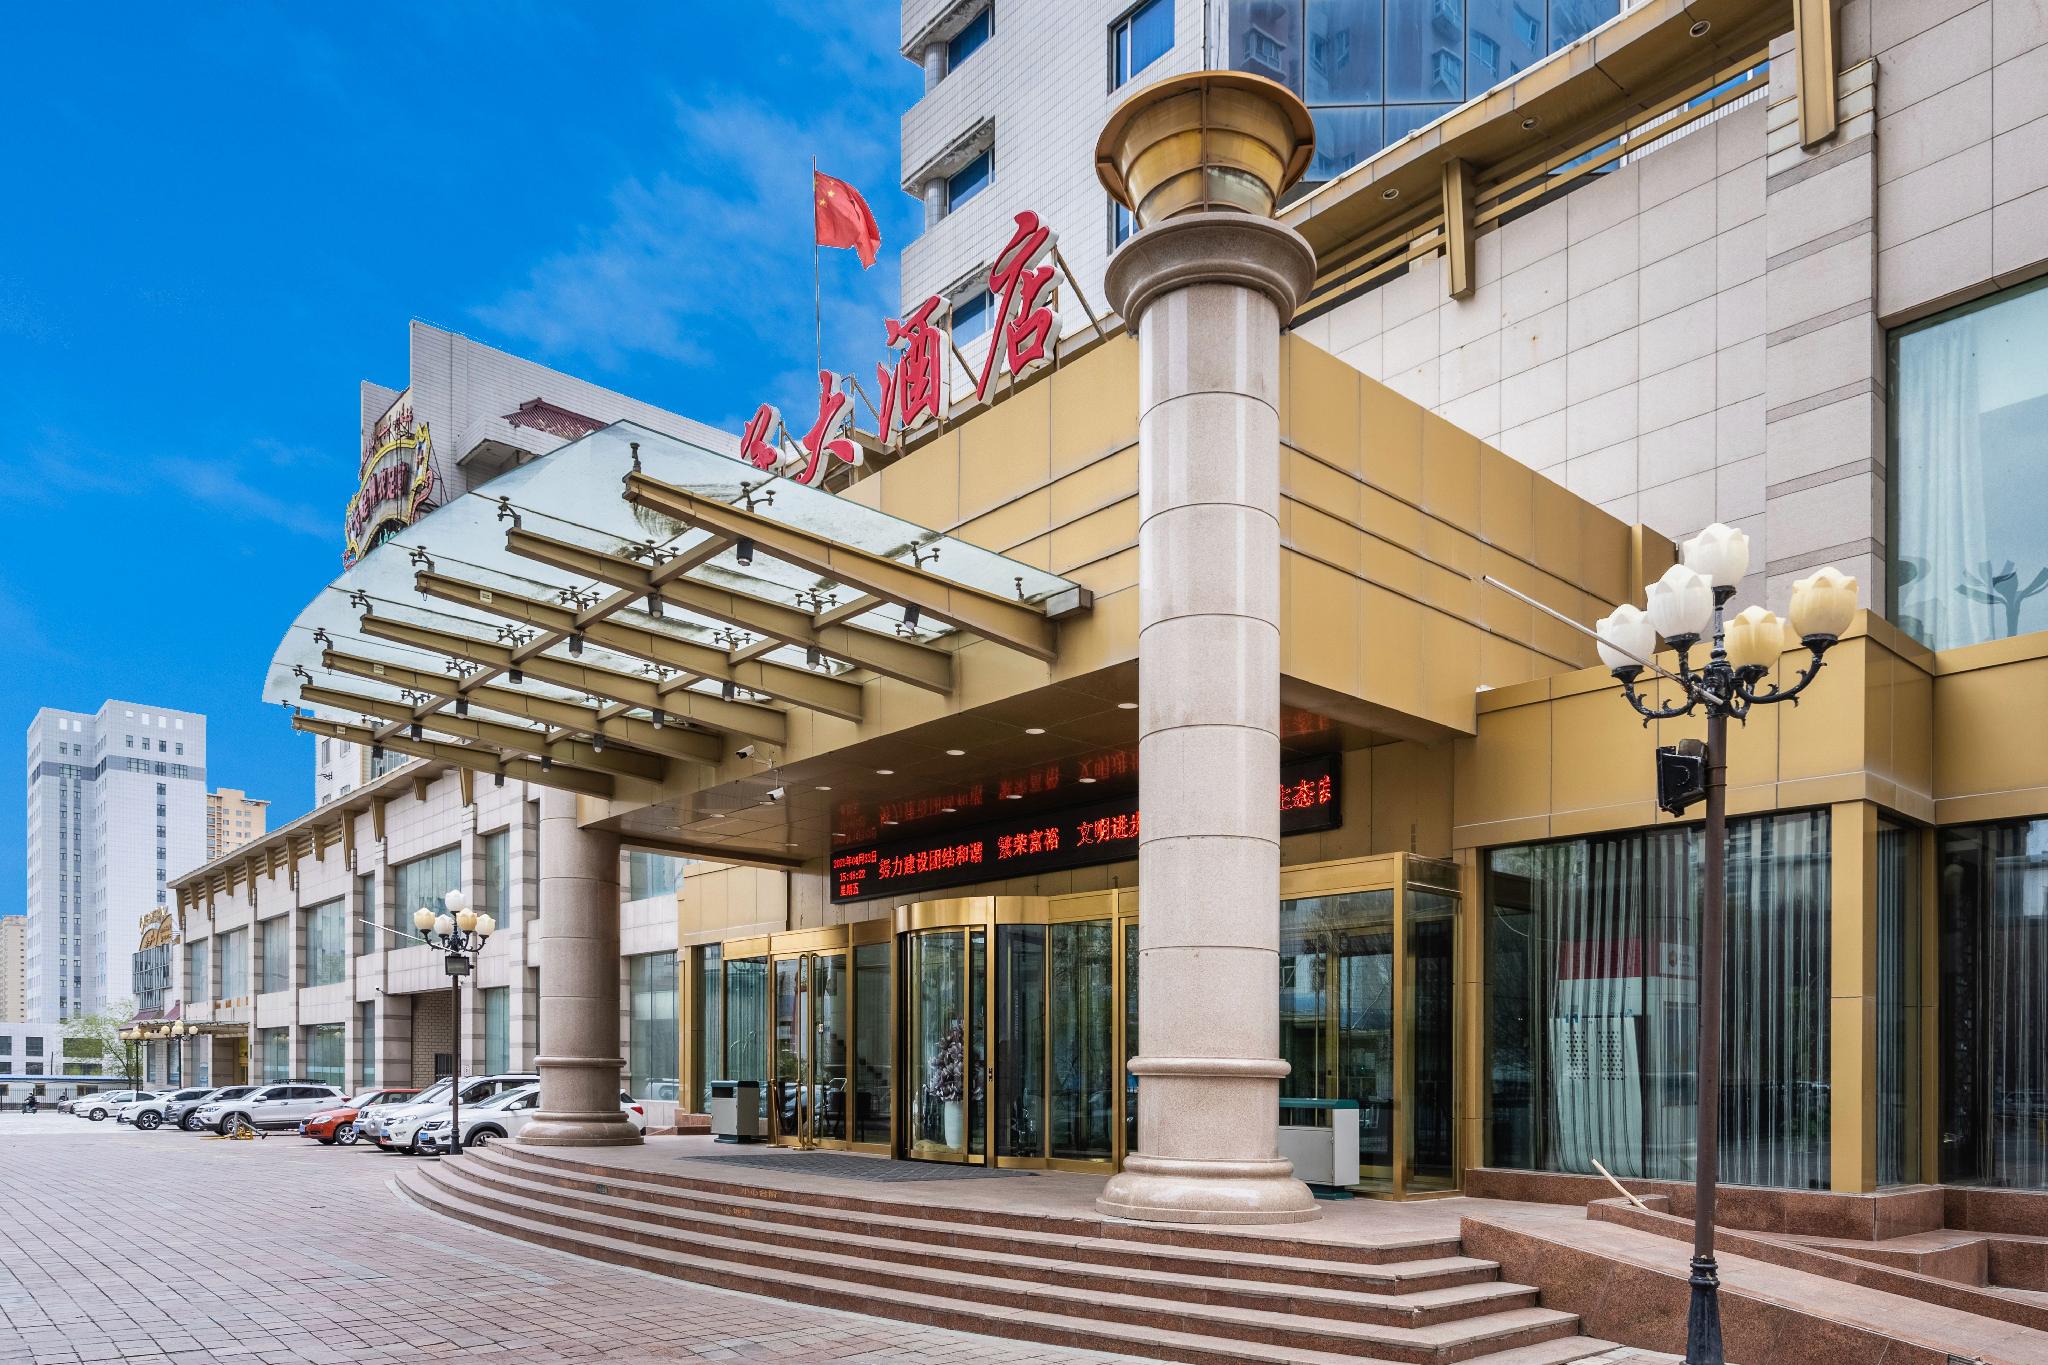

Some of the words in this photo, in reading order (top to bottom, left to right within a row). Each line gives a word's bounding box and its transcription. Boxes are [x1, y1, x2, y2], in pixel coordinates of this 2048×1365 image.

[879, 841, 983, 880] 努力建设团结和谐
[997, 827, 1060, 861] 繁荣富裕
[839, 882, 859, 897] 星期五
